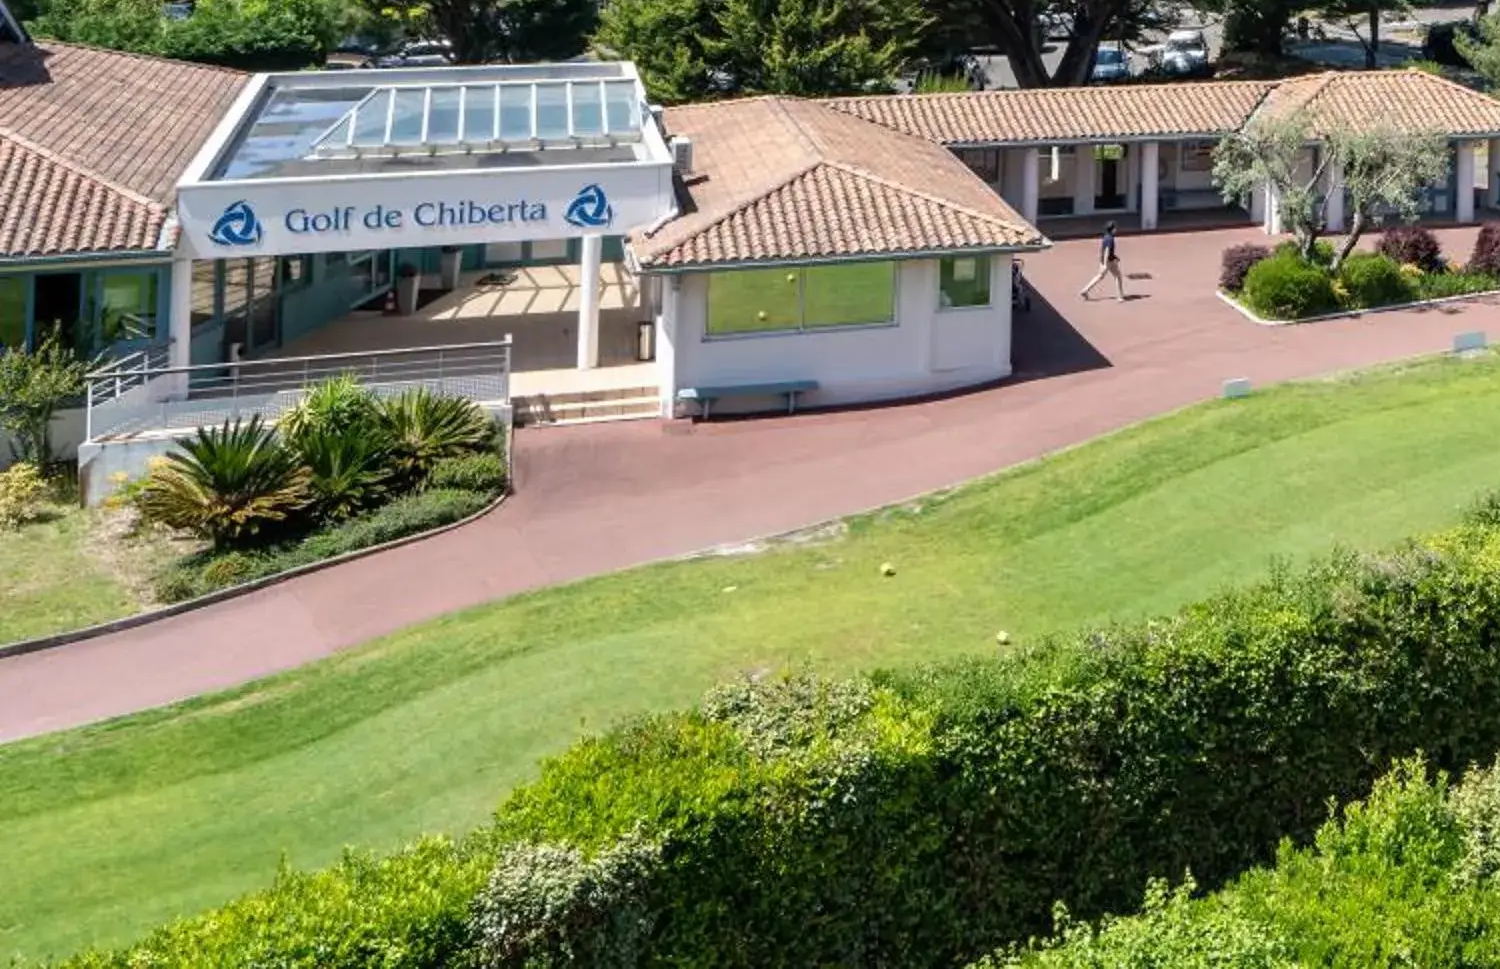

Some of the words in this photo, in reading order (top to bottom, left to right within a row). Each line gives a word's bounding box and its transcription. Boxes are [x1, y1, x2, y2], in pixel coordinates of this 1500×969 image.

[285, 205, 356, 233] Golf
[363, 204, 403, 229] de
[414, 199, 546, 226] Chiberta
